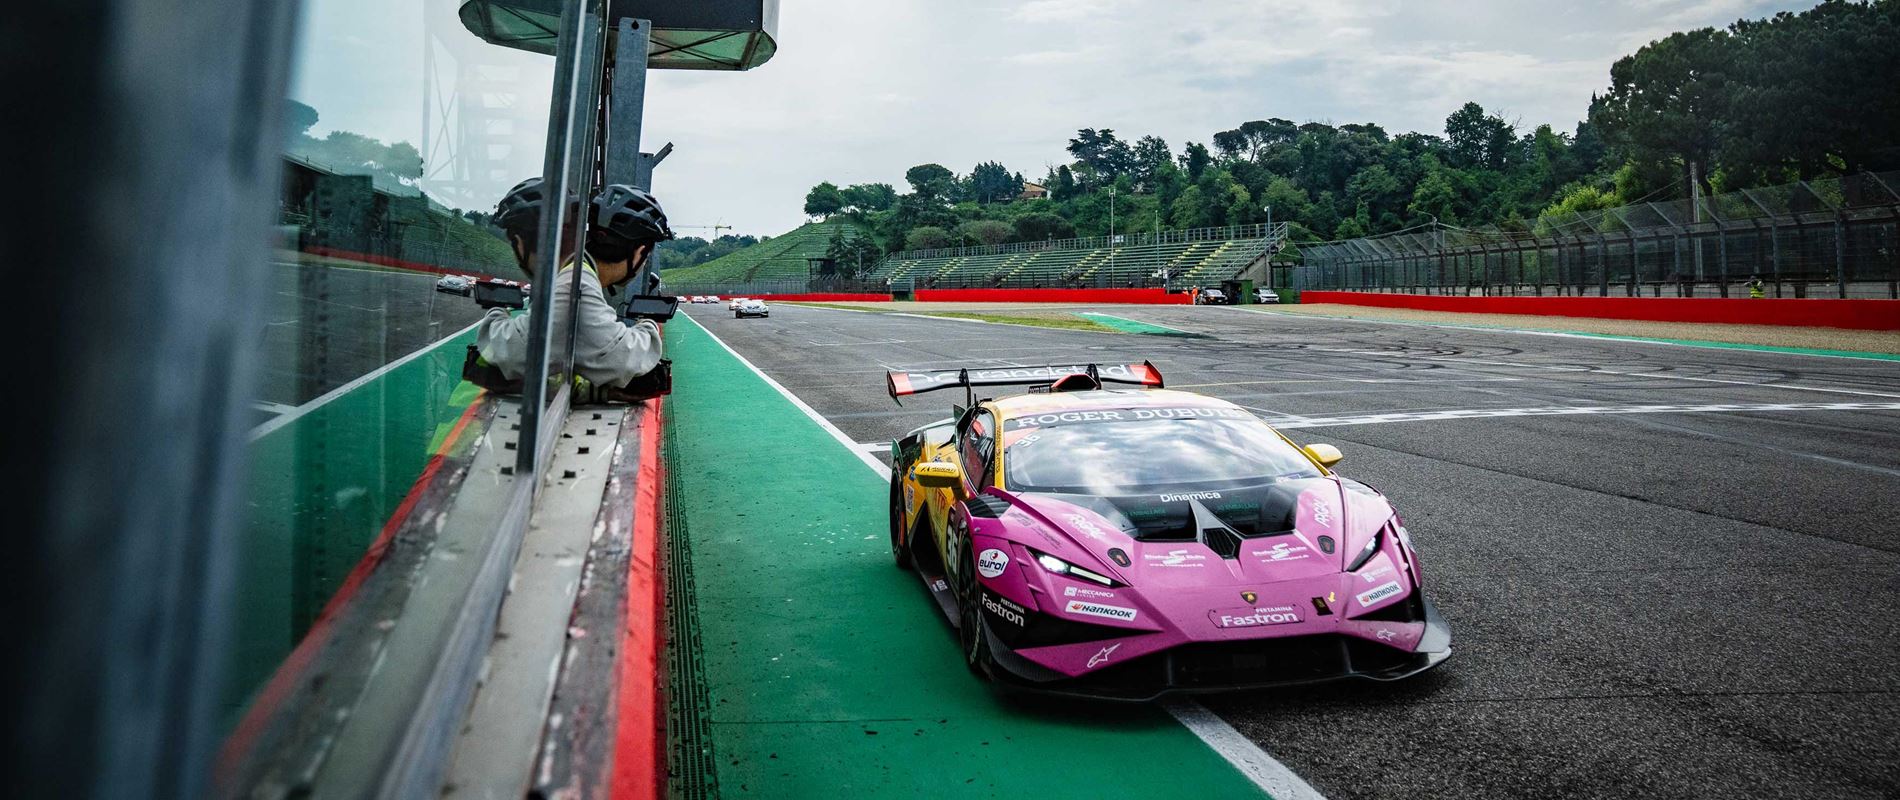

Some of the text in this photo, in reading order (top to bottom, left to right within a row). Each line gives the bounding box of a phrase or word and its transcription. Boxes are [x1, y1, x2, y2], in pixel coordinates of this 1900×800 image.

[1017, 409, 1122, 428] ROGER
[1015, 432, 1040, 448] 36
[1160, 491, 1222, 502] Dinamica
[979, 559, 1006, 571] eurol
[1077, 588, 1114, 598] MECCANICA
[981, 592, 1025, 628] Fastron
[1221, 612, 1299, 627] Fastron
